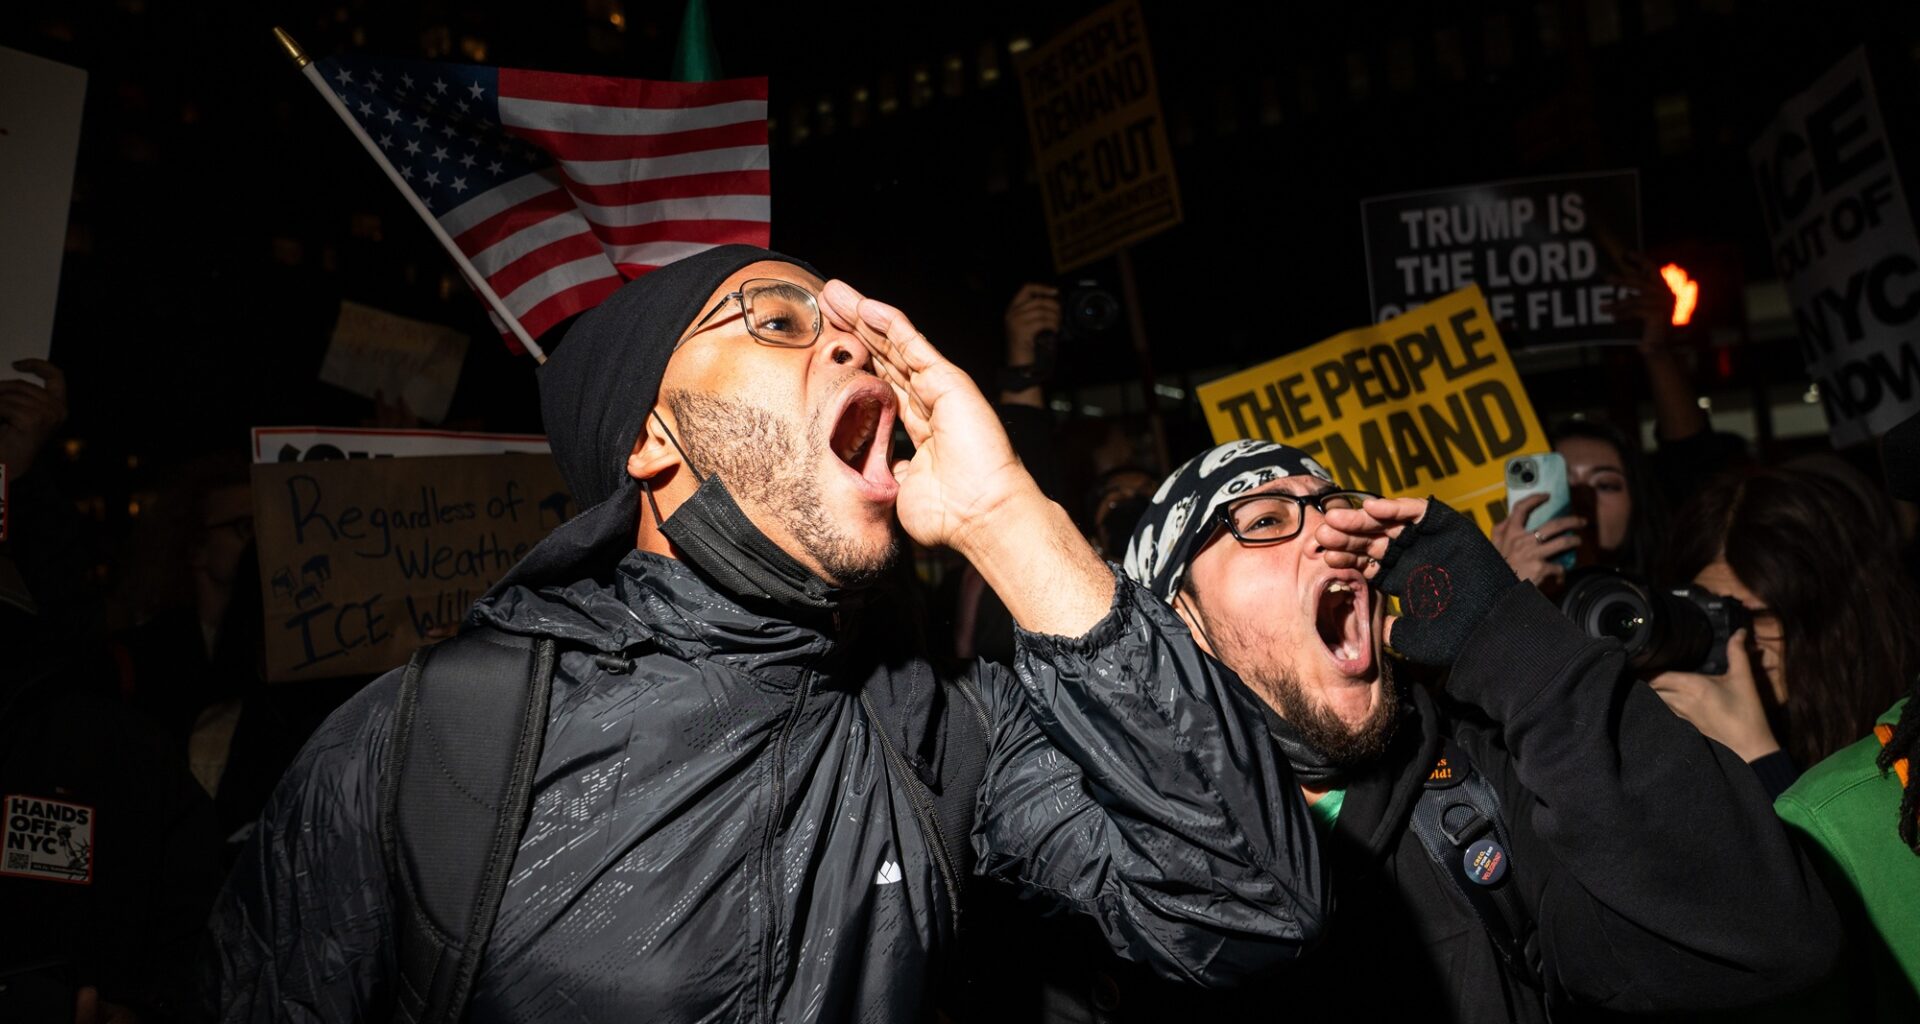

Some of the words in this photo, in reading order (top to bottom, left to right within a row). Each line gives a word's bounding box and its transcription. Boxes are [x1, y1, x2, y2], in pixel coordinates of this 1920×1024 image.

[1034, 53, 1148, 150] DEMAND
[1047, 150, 1093, 217] ICE
[1094, 116, 1157, 190] OUT
[1757, 78, 1886, 240] ICE
[1400, 196, 1535, 250] TRUMP
[1547, 191, 1588, 235] IS
[1776, 214, 1827, 278] OUT
[1832, 173, 1893, 240] OF
[1395, 249, 1476, 296] THE
[1487, 238, 1599, 288] LORD
[1797, 254, 1920, 363] NYC
[1218, 373, 1322, 442] THE
[1312, 308, 1497, 418] PEOPLE
[1296, 379, 1528, 498] MAND
[286, 474, 477, 558] Regardless
[486, 480, 525, 523] of
[285, 593, 388, 671] ICE
[8, 831, 58, 855] NYC
[11, 816, 57, 836] OFF
[12, 798, 89, 825] HANDS
